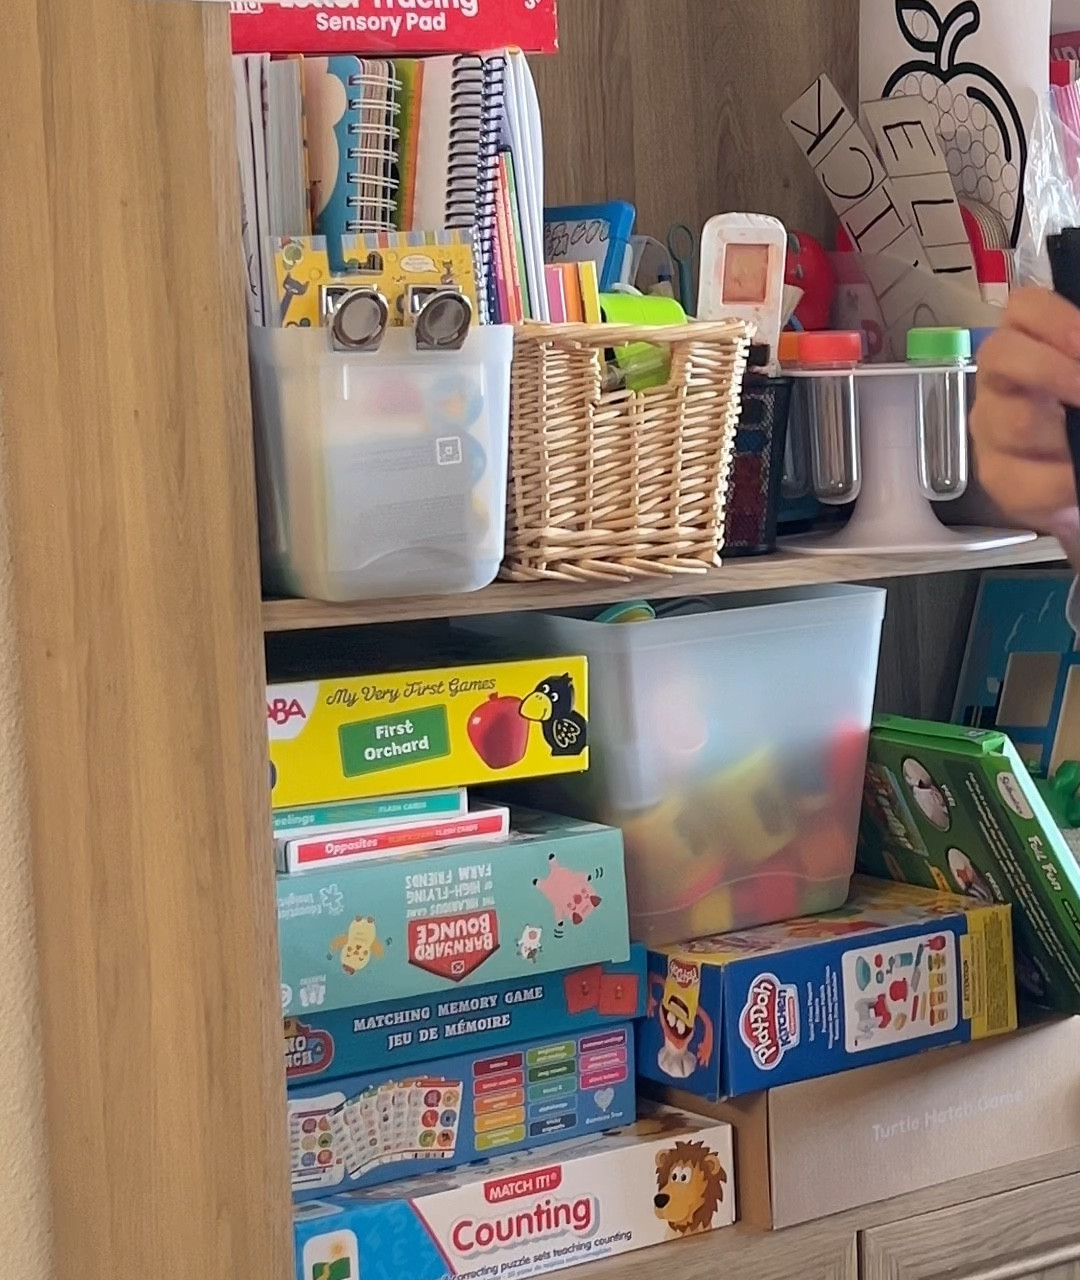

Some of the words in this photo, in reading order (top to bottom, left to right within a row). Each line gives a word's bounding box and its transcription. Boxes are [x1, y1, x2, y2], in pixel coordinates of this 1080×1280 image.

[316, 12, 403, 38] Sensory
[405, 12, 447, 31] Pad
[326, 687, 359, 708] My
[361, 685, 401, 703] Very
[403, 680, 447, 698] First
[449, 677, 497, 697] Games
[375, 720, 414, 740] First
[364, 735, 430, 761] Orchard
[272, 812, 315, 826] eelings
[324, 838, 379, 855] Opposites
[405, 869, 453, 889] FRIENDS
[458, 863, 492, 880] FARM
[406, 881, 480, 904] HIGH-FLYING
[416, 913, 490, 944] BOUNCE
[414, 932, 493, 961] BARNYARD
[354, 1007, 430, 1032] MATCHING
[438, 995, 498, 1018] MEMORY
[505, 986, 543, 1004] GAME
[388, 1032, 412, 1050] JEU
[419, 1028, 439, 1042] DE
[445, 1014, 511, 1038] MÉMOIRE
[749, 982, 777, 1064] Play-Doh
[871, 1115, 920, 1142] Turtle
[977, 1089, 1022, 1112] Game
[490, 1179, 533, 1201] MATCH
[453, 1198, 591, 1251] Counting
[501, 1255, 531, 1271] puzzle
[533, 1250, 551, 1263] sets
[553, 1240, 592, 1257] teaching
[594, 1230, 632, 1247] counting
